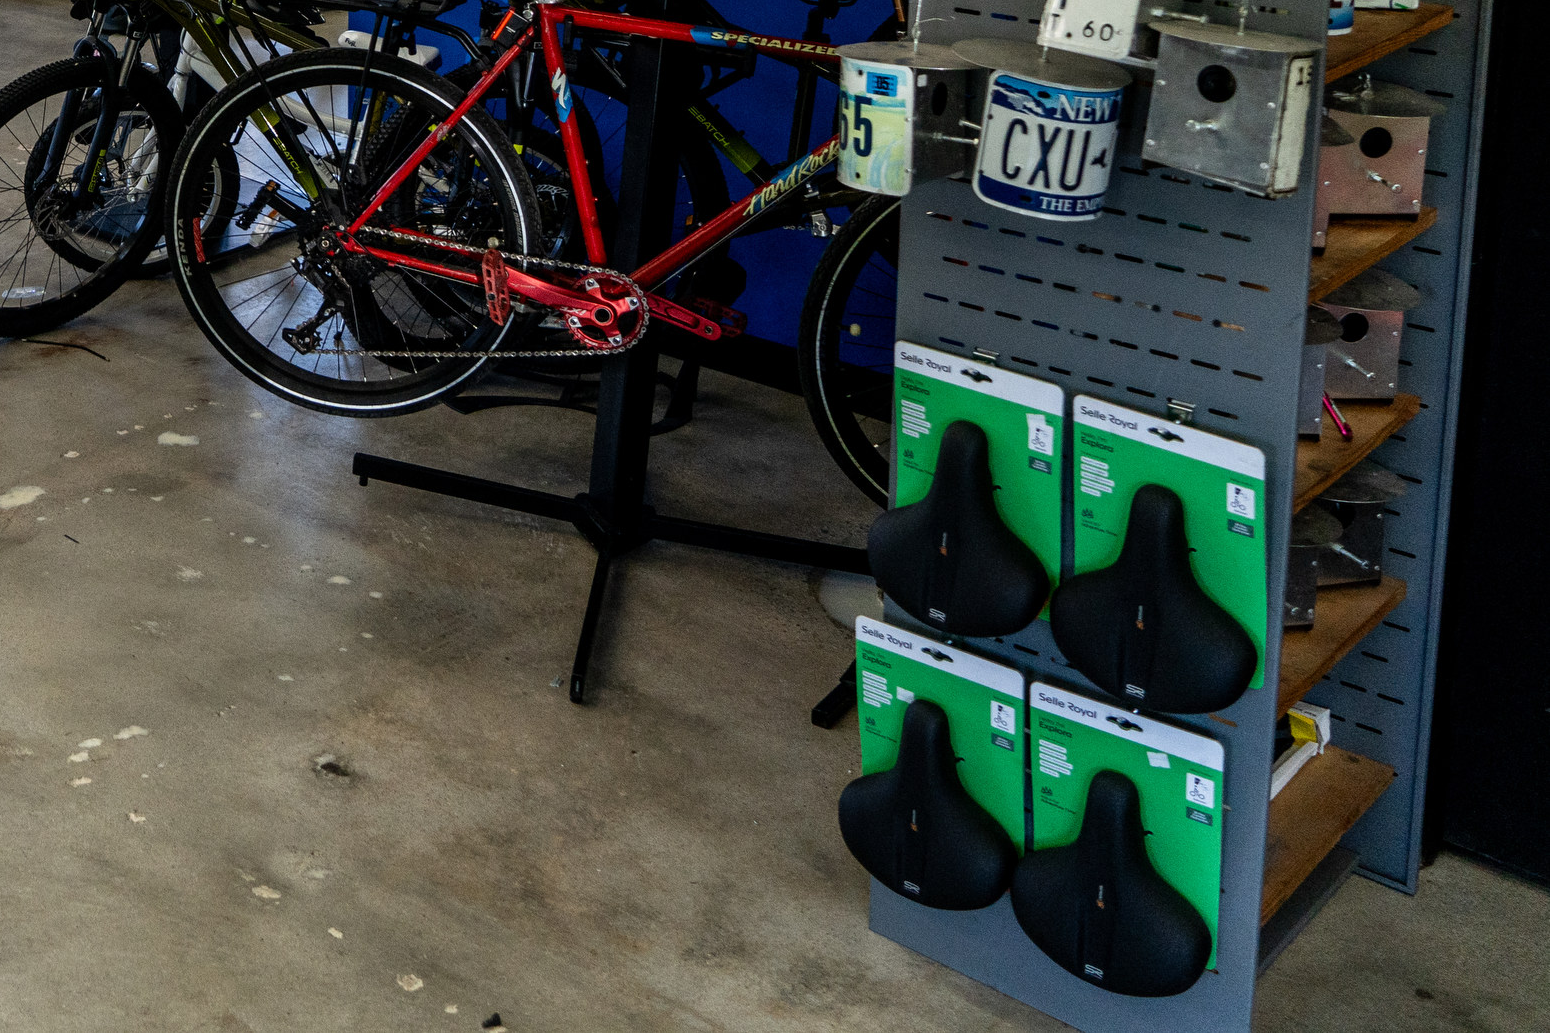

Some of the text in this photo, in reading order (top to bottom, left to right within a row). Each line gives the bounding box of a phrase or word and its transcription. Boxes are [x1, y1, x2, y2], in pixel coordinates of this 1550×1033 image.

[1082, 19, 1115, 42] 60
[711, 31, 838, 56] SPECIALIZED
[1055, 93, 1114, 123] NEW
[694, 112, 731, 148] BATCH
[1002, 117, 1092, 192] CXU
[1039, 195, 1073, 213] THE
[177, 218, 194, 277] KENDA
[900, 351, 952, 373] Selle Royal
[900, 381, 931, 396] Explora
[1080, 405, 1138, 431] Selle Royal
[1080, 436, 1114, 453] Explora
[861, 625, 913, 650] Selle Royal
[862, 653, 892, 669] Explora
[1038, 692, 1098, 719] Selle Royal
[1038, 721, 1073, 739] Explora
